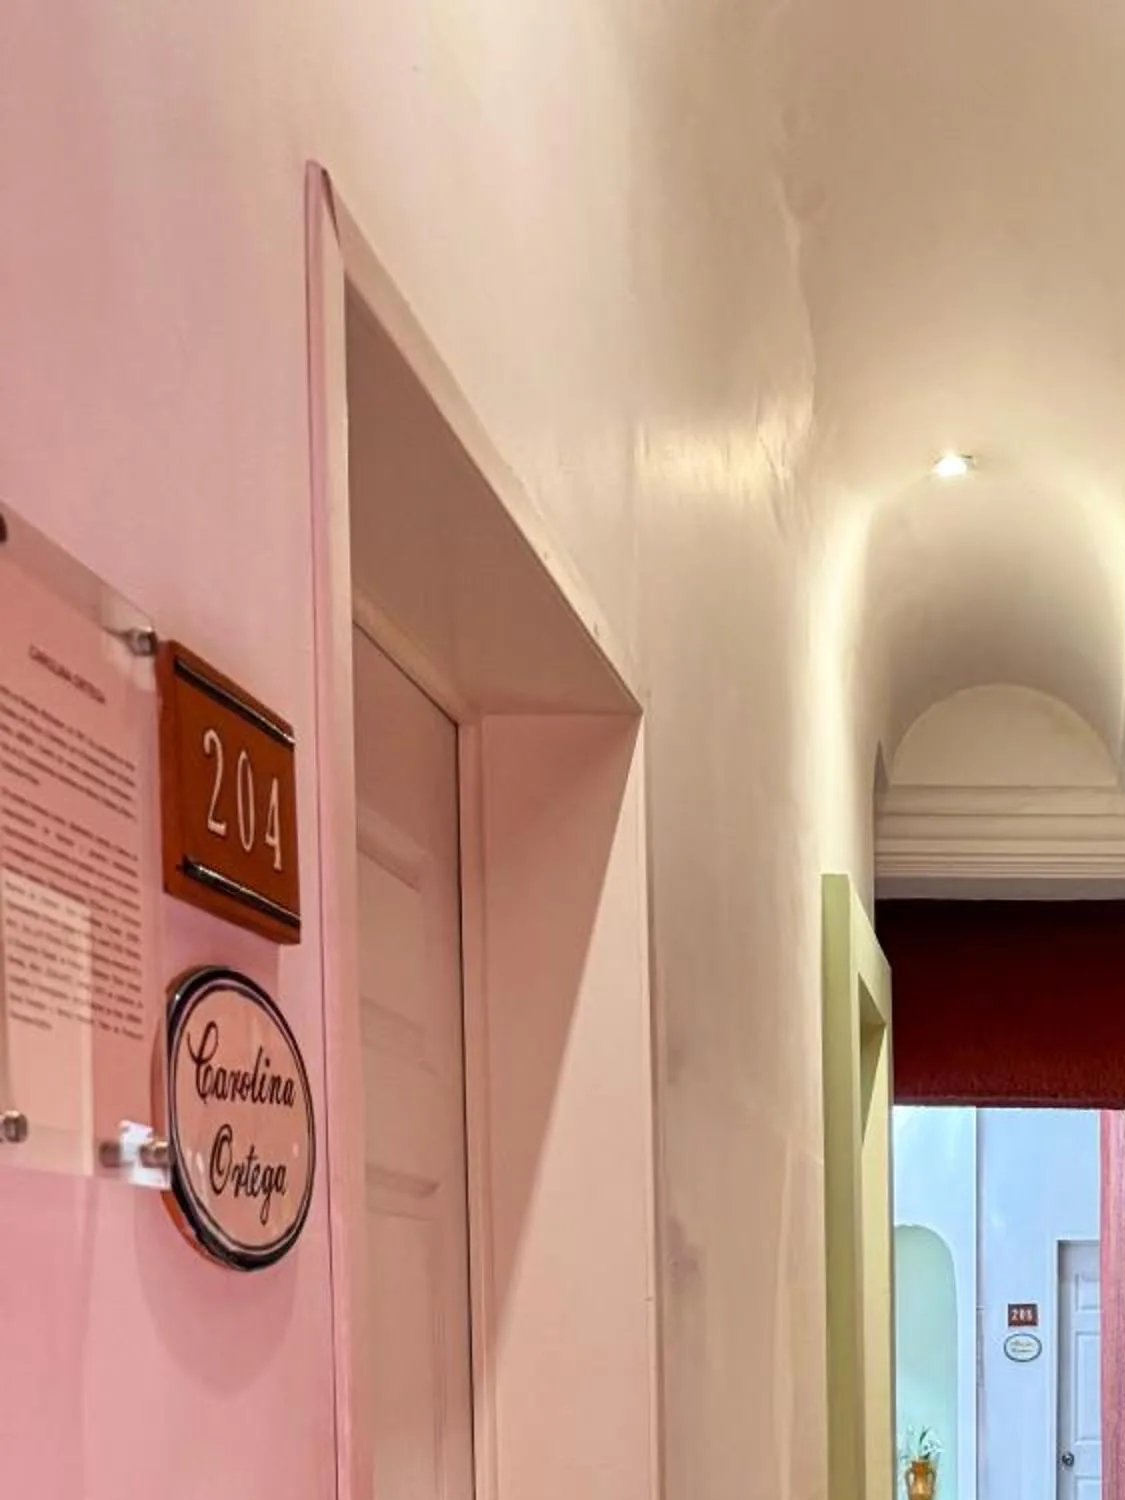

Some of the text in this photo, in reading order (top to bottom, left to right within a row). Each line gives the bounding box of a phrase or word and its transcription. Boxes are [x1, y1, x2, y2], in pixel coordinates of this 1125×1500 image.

[203, 729, 282, 870] 204
[187, 1021, 296, 1108] Carolina
[209, 1123, 287, 1225] Ortega
